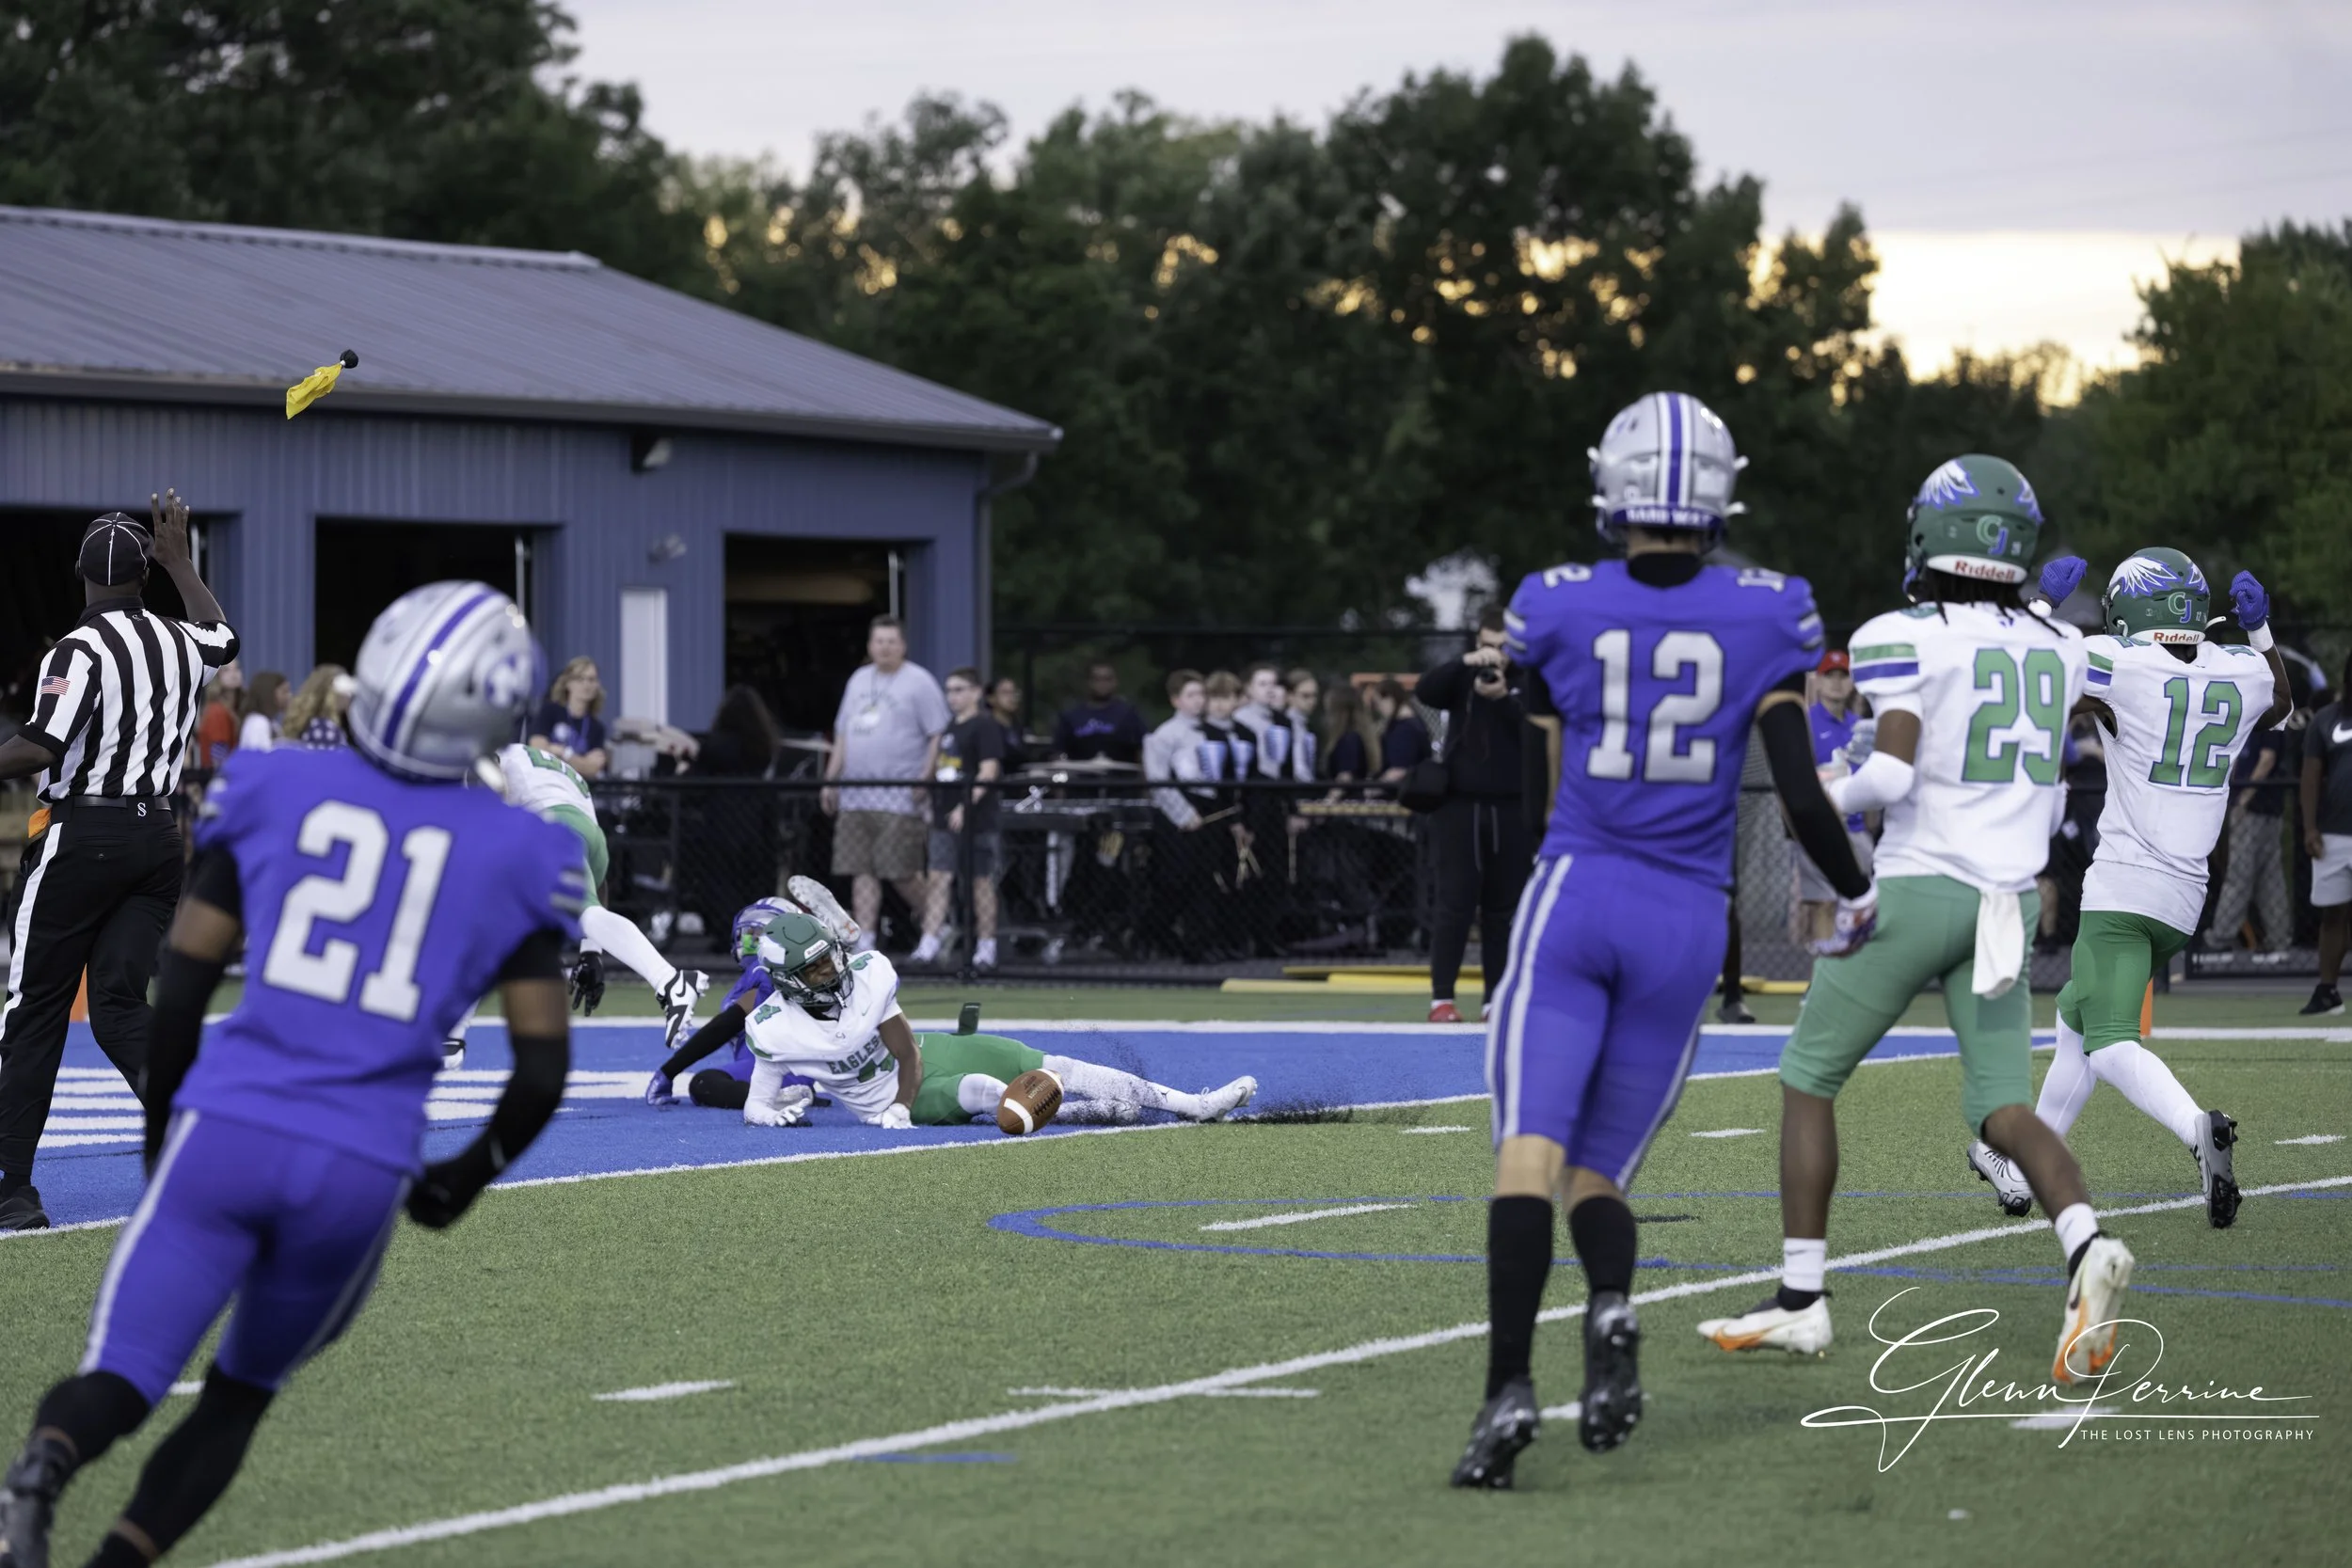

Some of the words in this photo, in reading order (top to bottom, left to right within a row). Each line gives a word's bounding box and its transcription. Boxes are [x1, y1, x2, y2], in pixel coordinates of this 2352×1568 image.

[1976, 515, 2009, 555] CJ
[1955, 560, 2016, 581] Riddell
[2168, 592, 2192, 623] CJ
[2153, 632, 2200, 643] Riddell
[1587, 628, 1724, 784] 12
[1962, 648, 2065, 785] 29
[2148, 676, 2242, 788] 12
[137, 801, 147, 817] S
[262, 800, 452, 1022] 21
[826, 1035, 881, 1075] EAGLES
